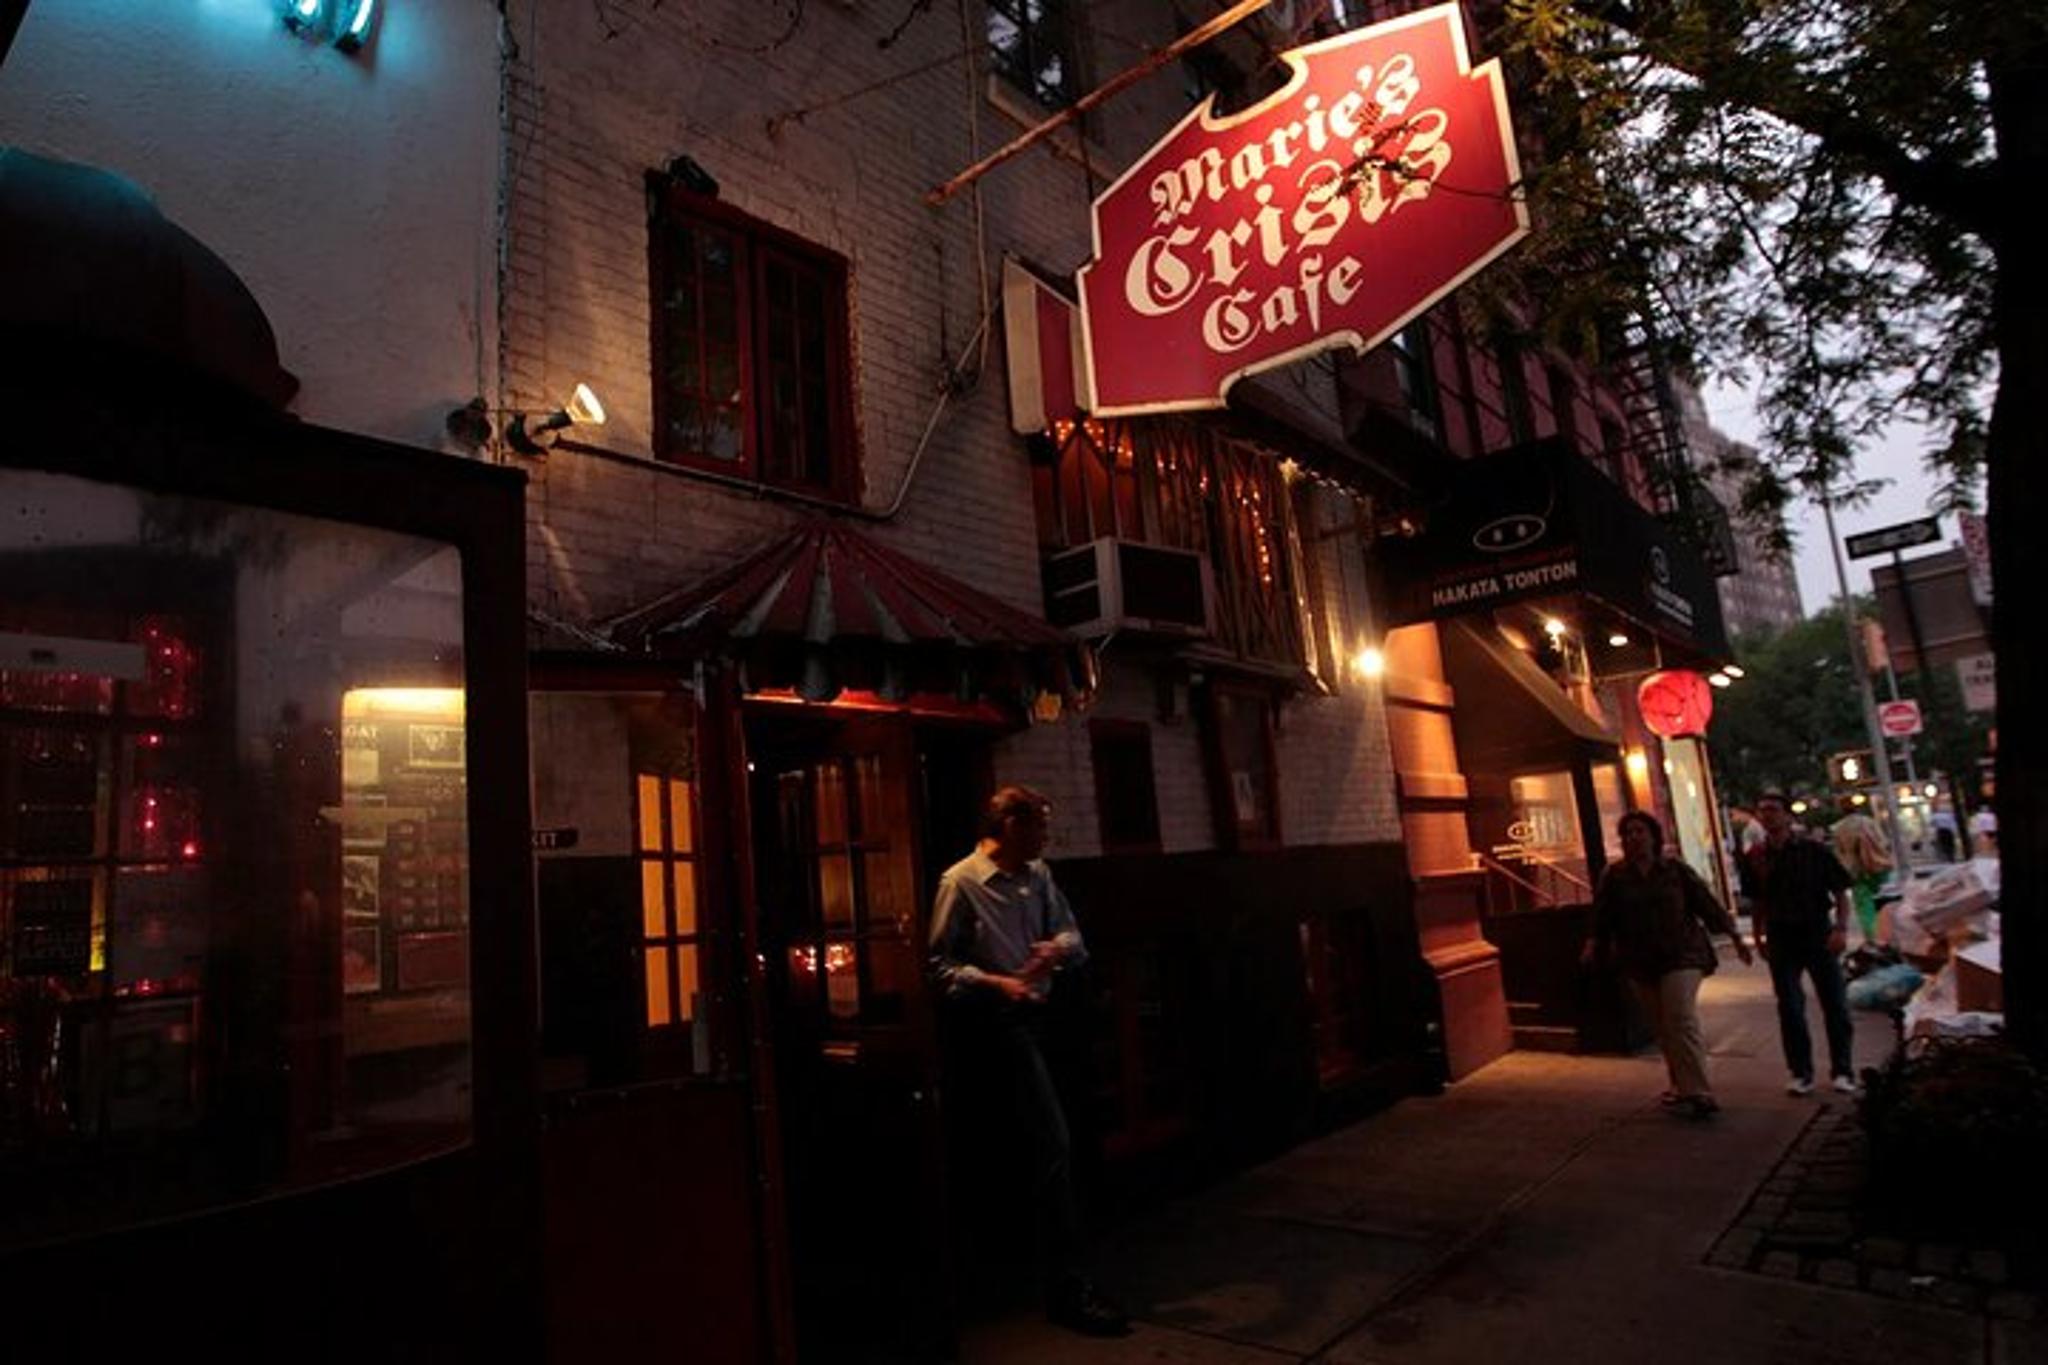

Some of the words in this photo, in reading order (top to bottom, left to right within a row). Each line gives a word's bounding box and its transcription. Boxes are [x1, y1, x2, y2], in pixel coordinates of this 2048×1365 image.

[1151, 54, 1420, 228] Marie's
[1125, 109, 1452, 316] Crisis
[1202, 253, 1363, 353] Cafe
[1503, 559, 1578, 591] TONTON
